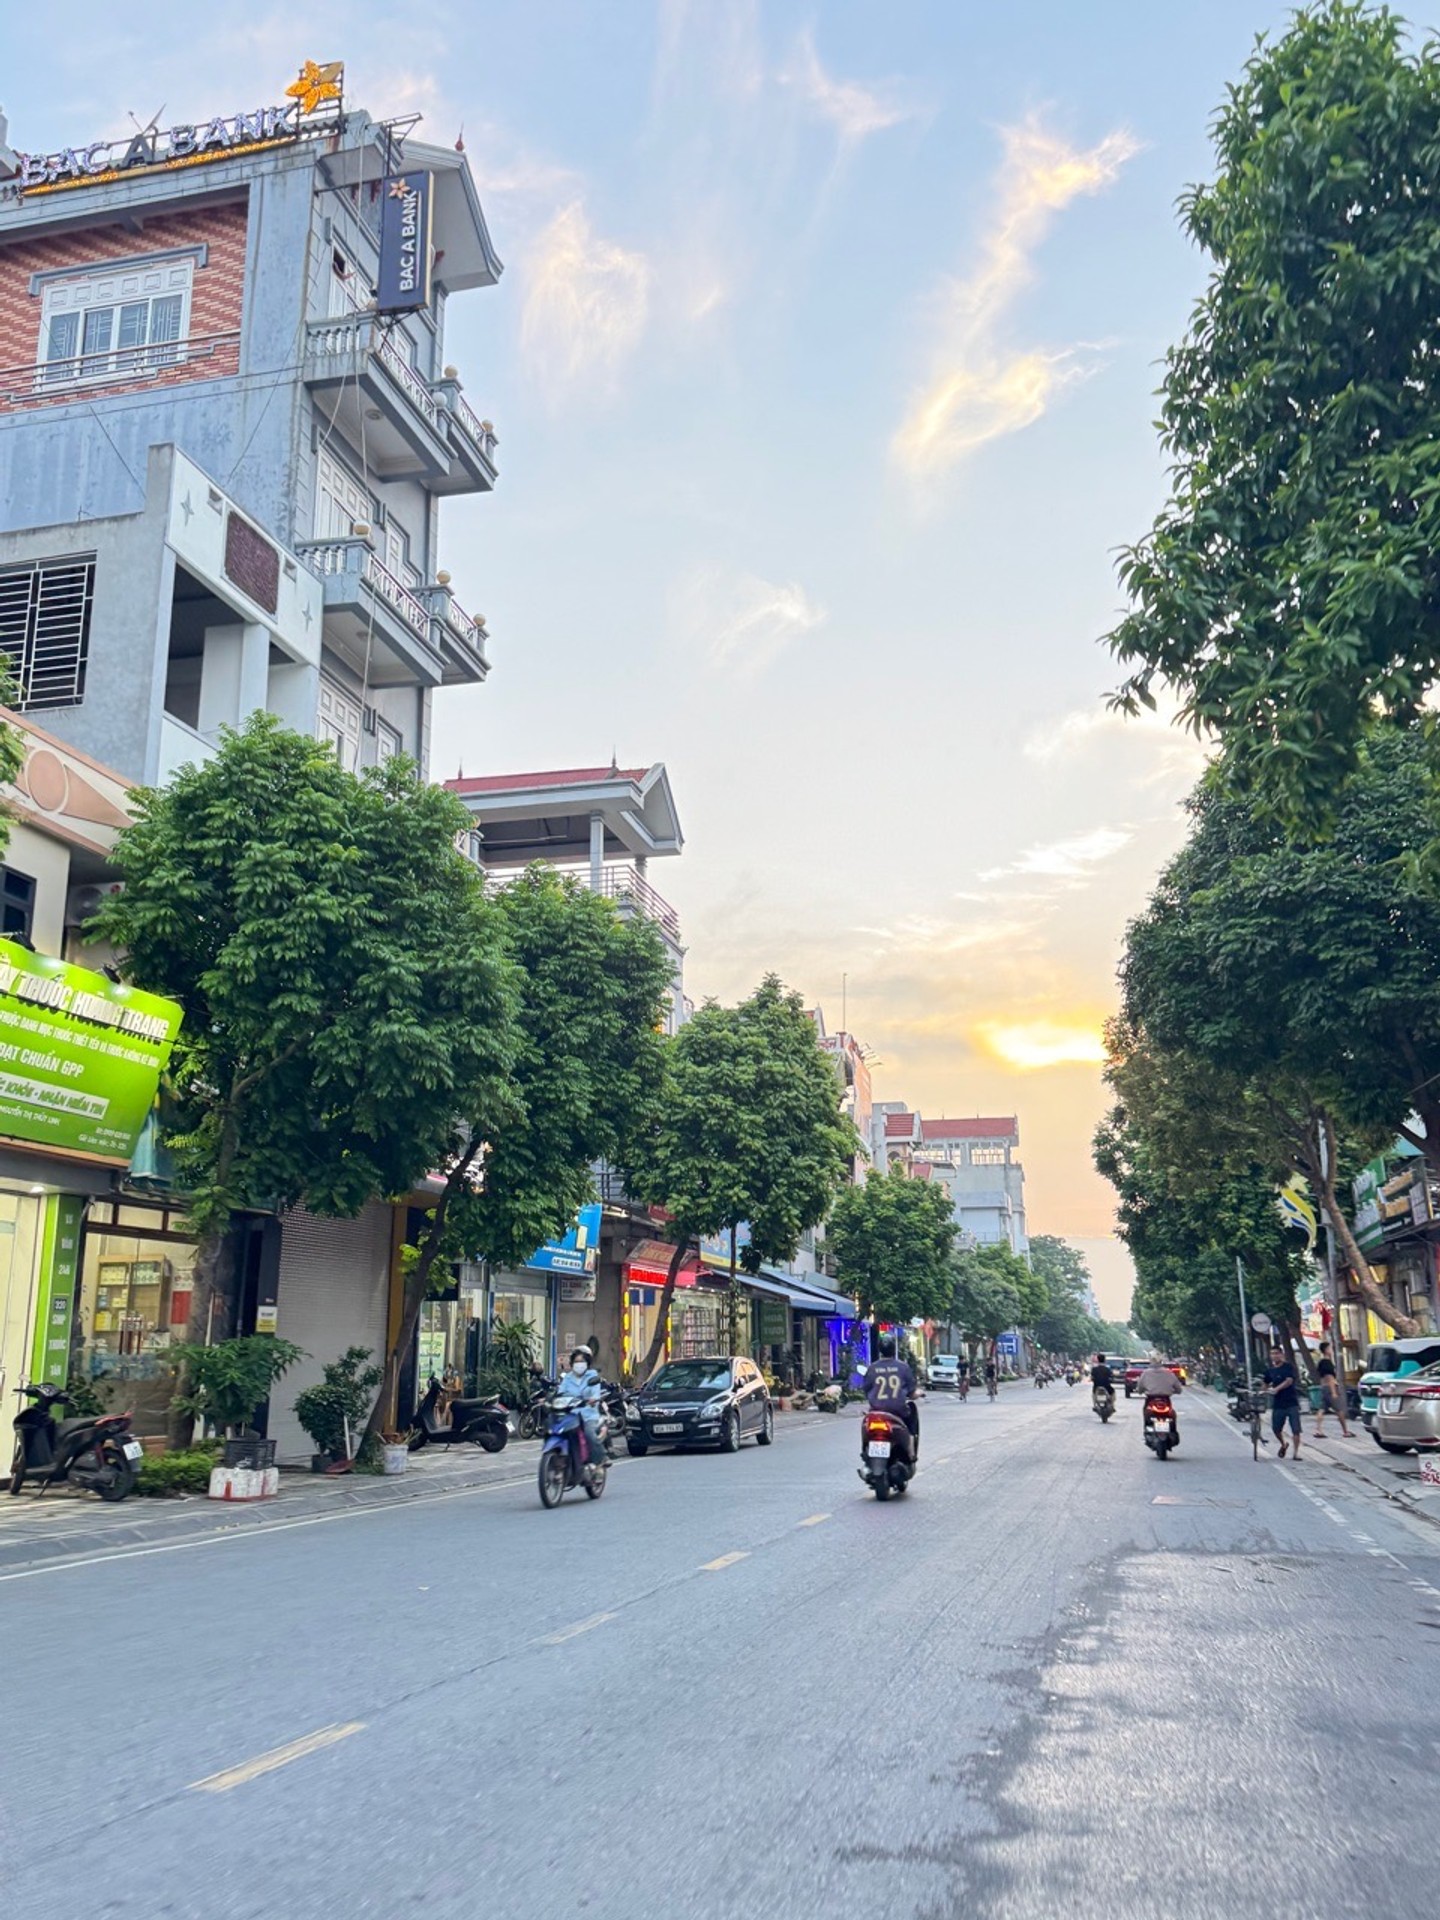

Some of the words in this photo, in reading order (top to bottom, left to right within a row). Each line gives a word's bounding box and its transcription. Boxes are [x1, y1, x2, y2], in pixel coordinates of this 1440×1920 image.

[20, 141, 110, 187] BAC
[167, 102, 296, 158] BANK
[402, 190, 417, 237] BANK
[401, 239, 415, 254] A
[400, 255, 414, 292] BAC
[122, 1007, 170, 1040] TRANG
[20, 1048, 62, 1073] CHUẨN
[61, 1060, 85, 1078] GPP
[875, 1375, 899, 1399] 29
